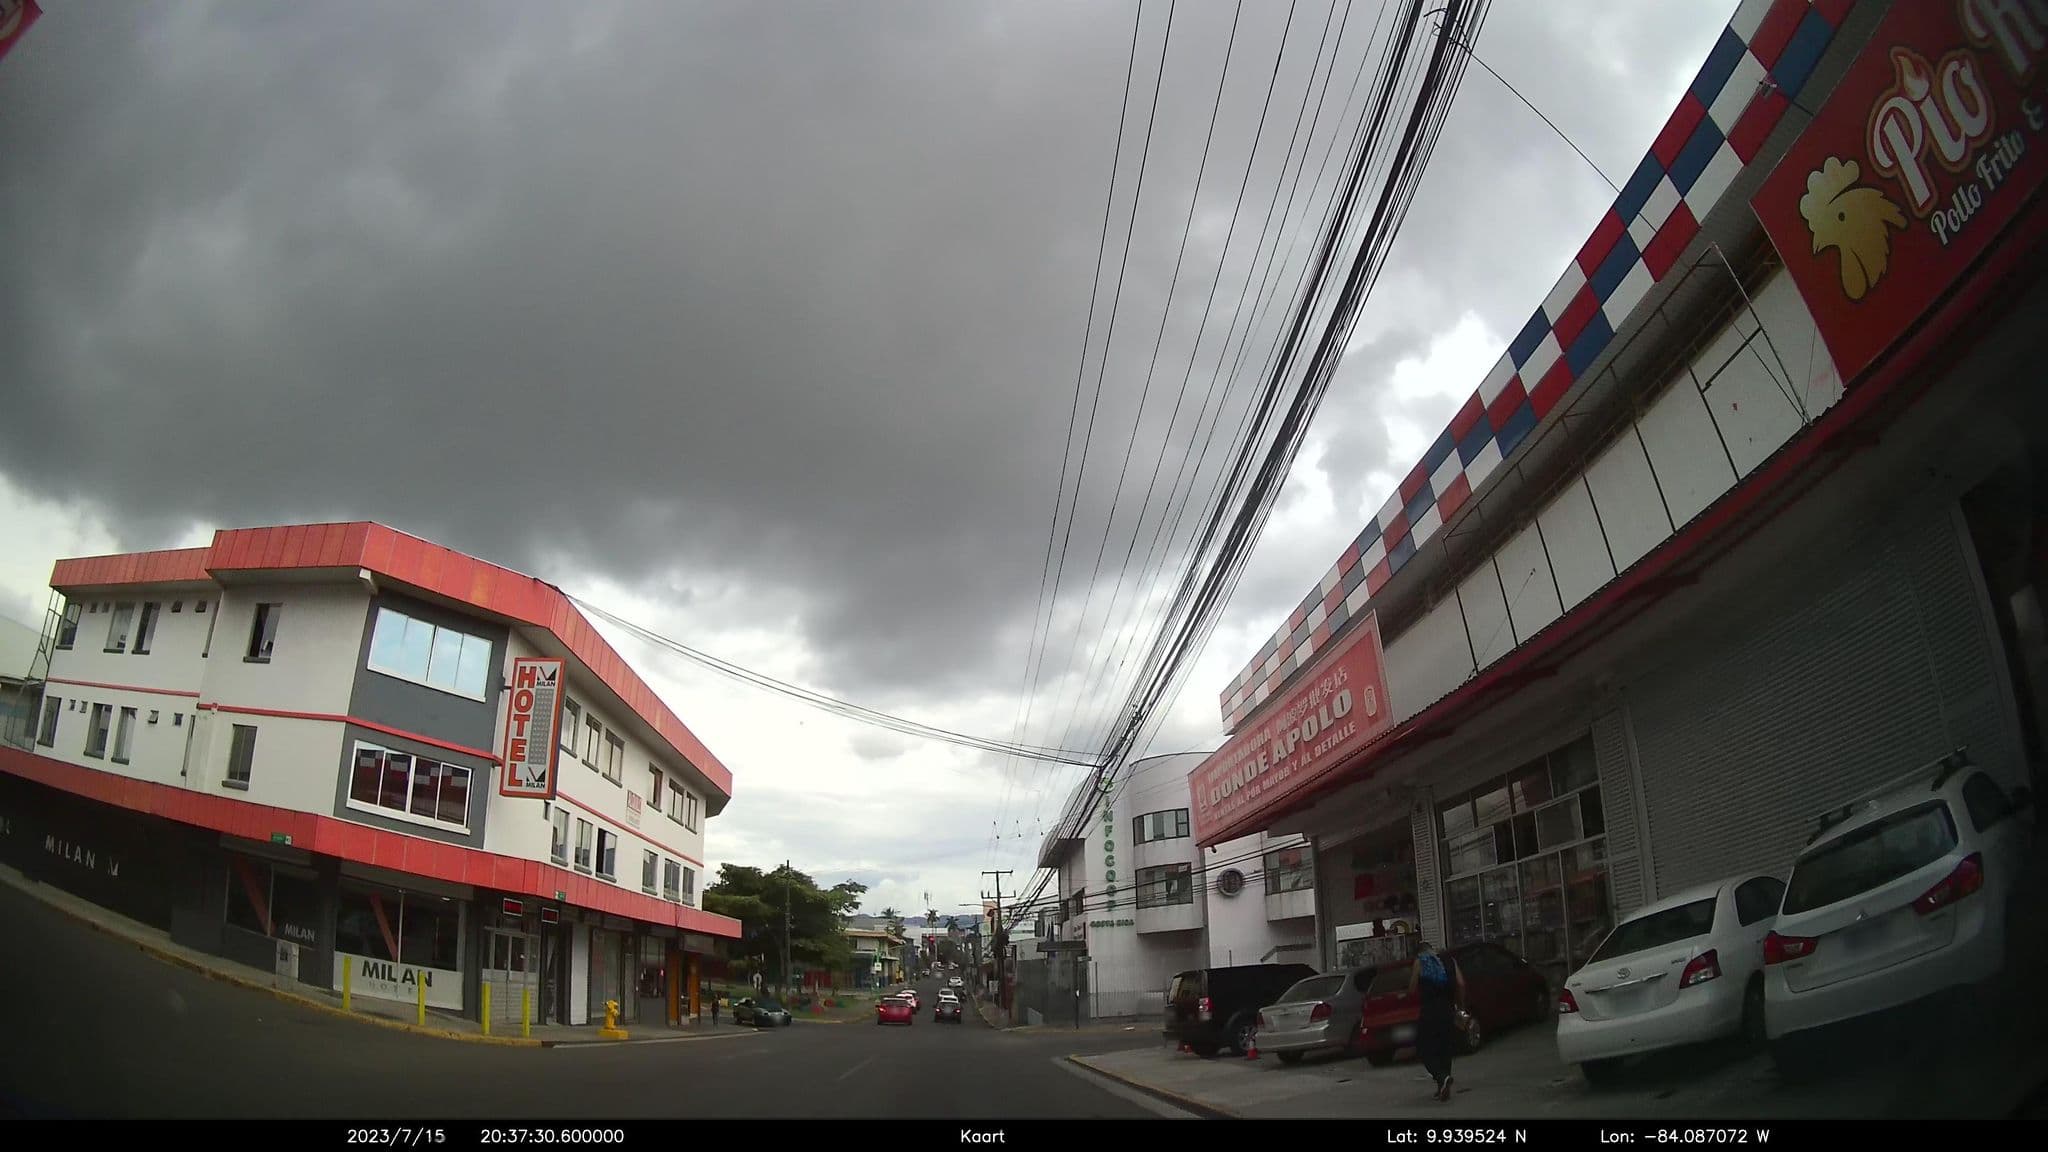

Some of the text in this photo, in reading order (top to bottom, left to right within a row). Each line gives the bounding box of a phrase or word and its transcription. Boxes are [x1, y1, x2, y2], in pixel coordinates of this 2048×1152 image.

[1930, 183, 1983, 246] Pollo
[1975, 130, 2026, 191] Frito
[507, 666, 537, 787] HOTEL
[1210, 688, 1354, 807] DONDE APOLO
[1291, 760, 1298, 772] Y
[1301, 755, 1312, 768] AL
[1313, 722, 1357, 758] DETALLE
[525, 781, 546, 789] MILAN
[45, 834, 96, 870] MILAN
[284, 923, 316, 942] MILAN
[361, 960, 433, 988] MILAN
